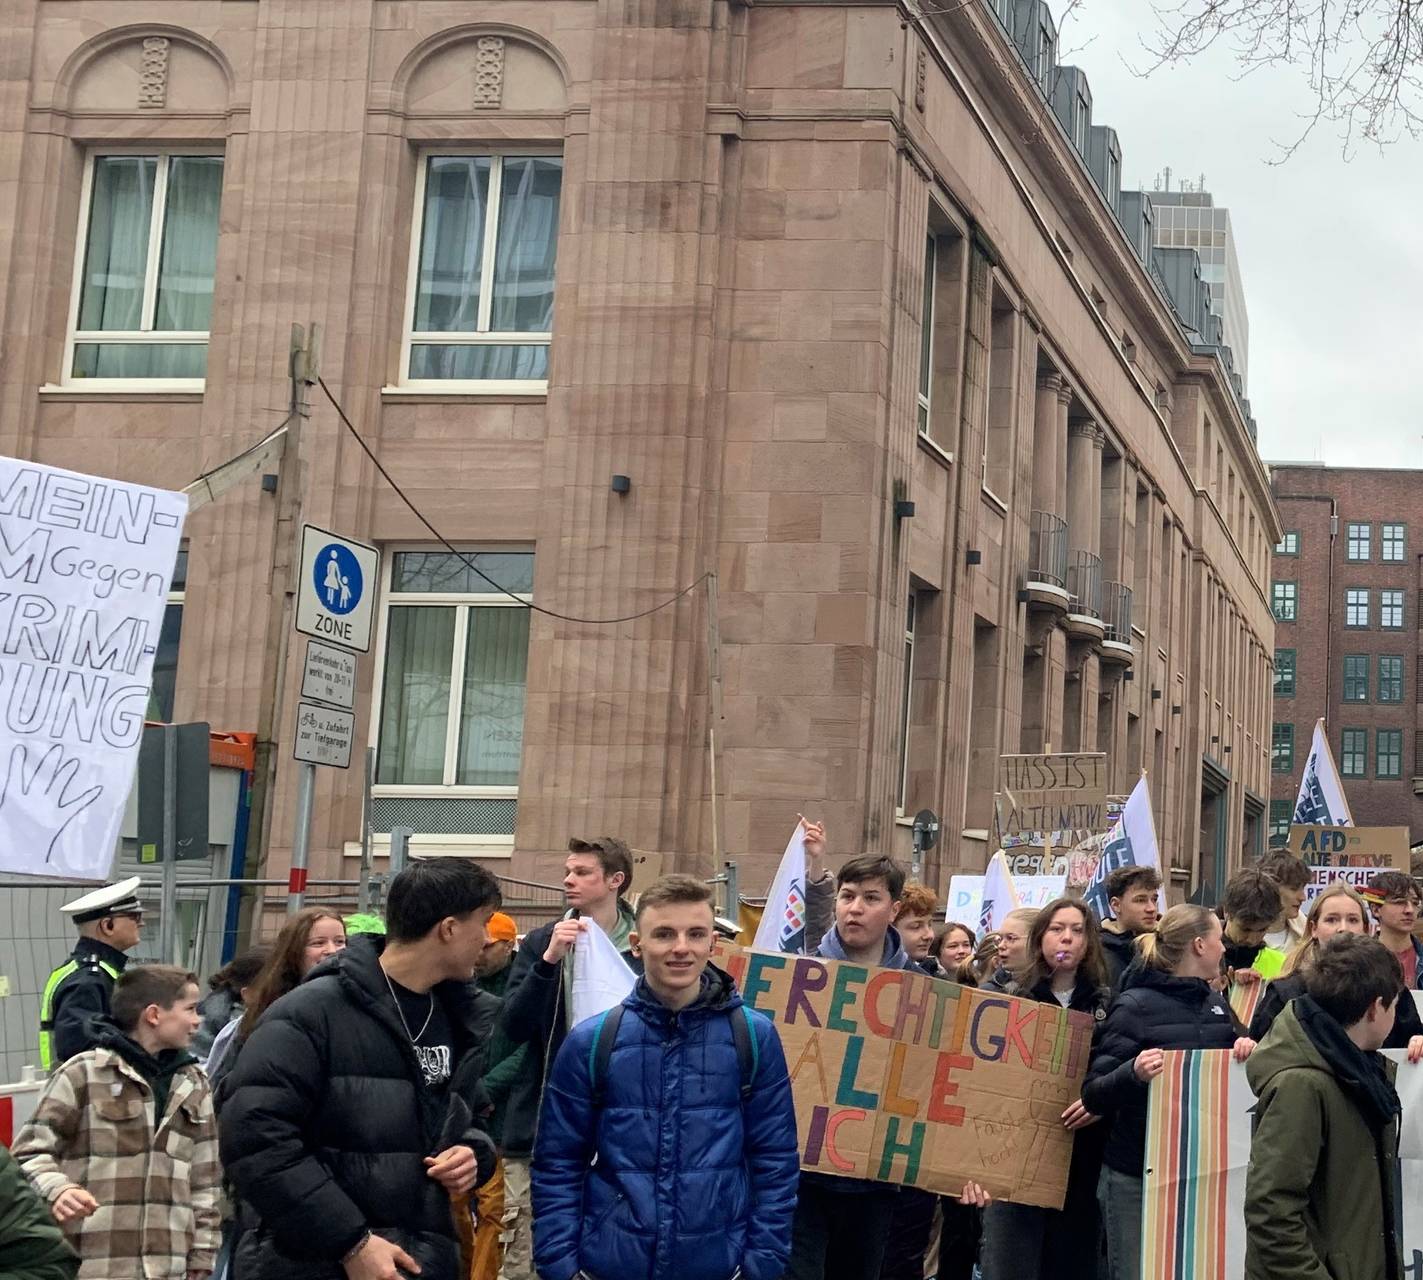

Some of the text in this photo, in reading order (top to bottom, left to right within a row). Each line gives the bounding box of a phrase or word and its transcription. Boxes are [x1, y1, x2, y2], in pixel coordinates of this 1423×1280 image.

[51, 546, 164, 599] Gegen
[0, 592, 155, 676] RIMI-
[315, 613, 352, 640] ZONE
[0, 663, 149, 749] UNG
[326, 721, 350, 735] Zufahrt
[301, 731, 348, 748] zur Tiefgarage
[1059, 756, 1103, 789] IST
[713, 948, 1095, 1079] ERECHTIGKEIT
[790, 1031, 974, 1127] ALLE
[802, 1105, 926, 1185] ICH
